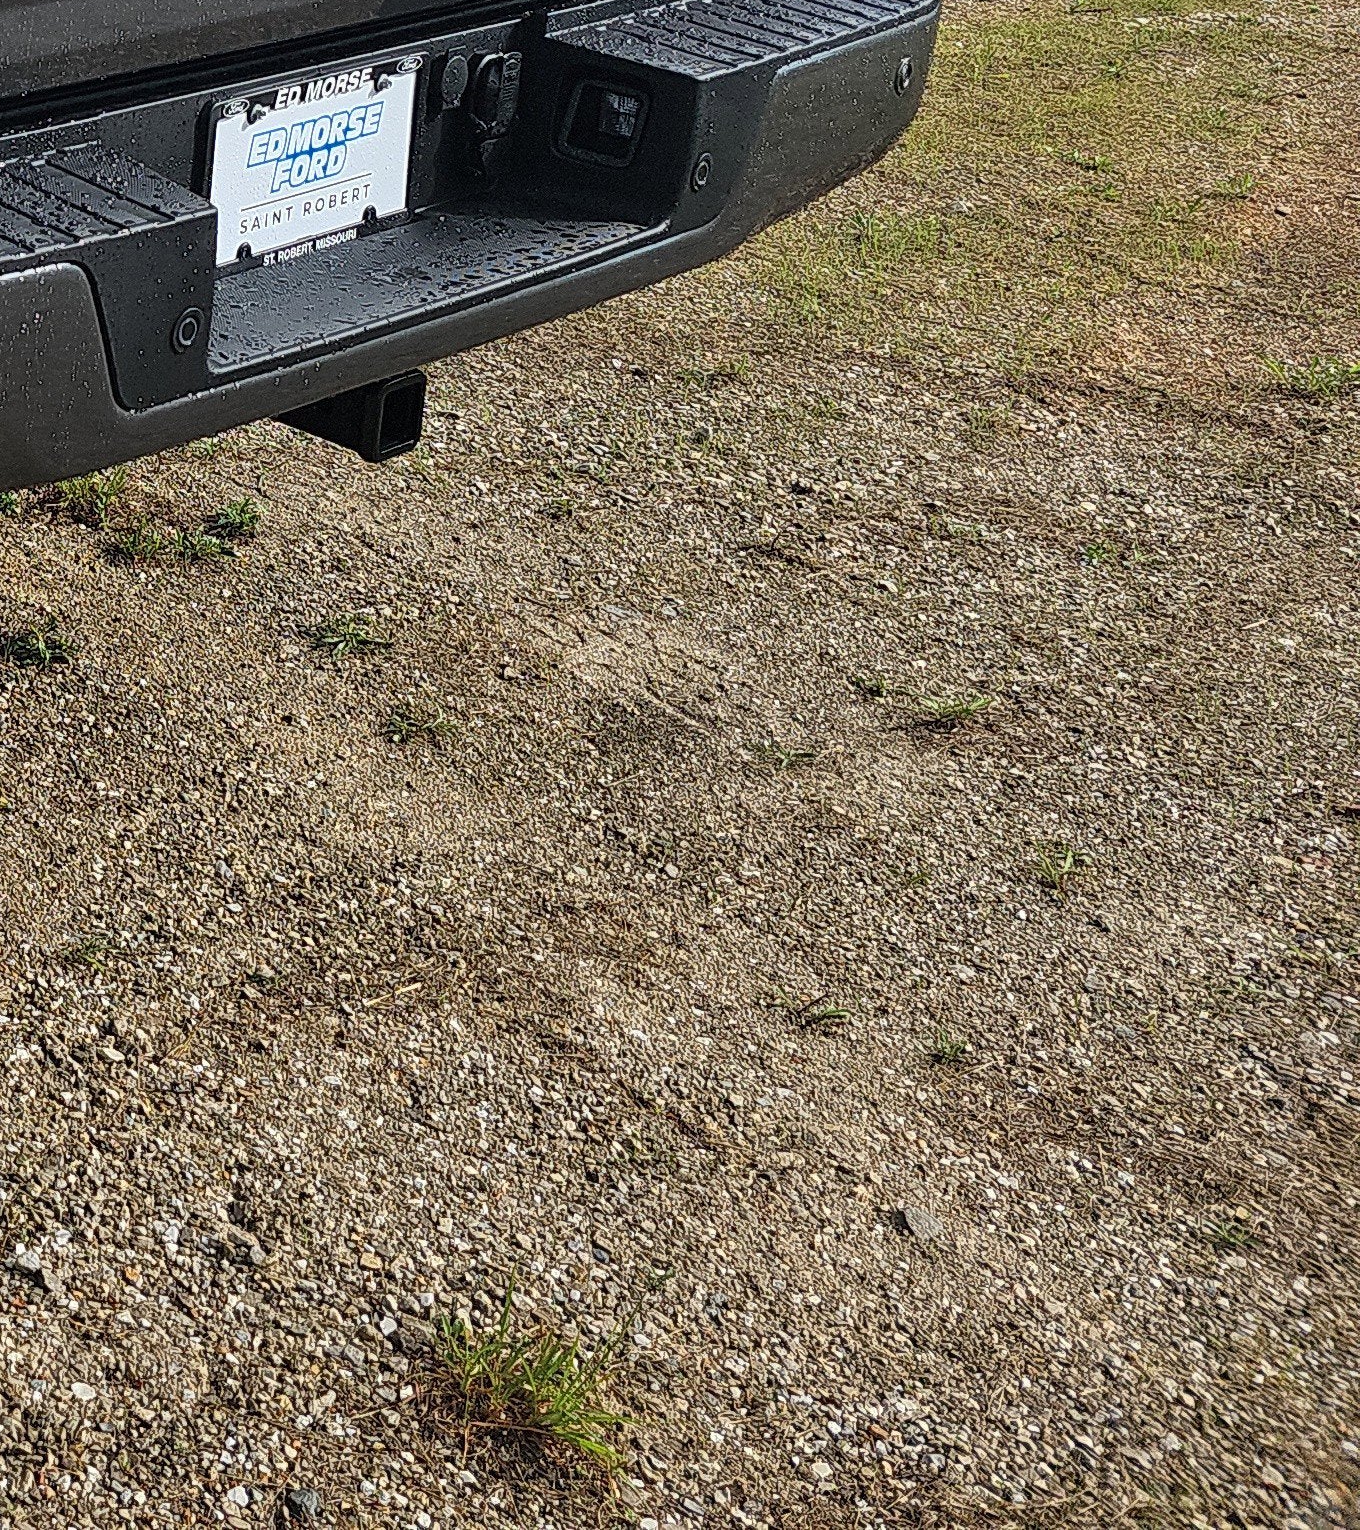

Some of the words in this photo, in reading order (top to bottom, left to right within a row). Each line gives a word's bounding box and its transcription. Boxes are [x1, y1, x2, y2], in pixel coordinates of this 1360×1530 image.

[274, 86, 301, 110] ED
[304, 67, 373, 104] MORSE
[269, 143, 348, 194] FORD
[239, 205, 294, 235] SAINT
[302, 183, 371, 217] ROBERT
[315, 227, 358, 250] MISSOURI
